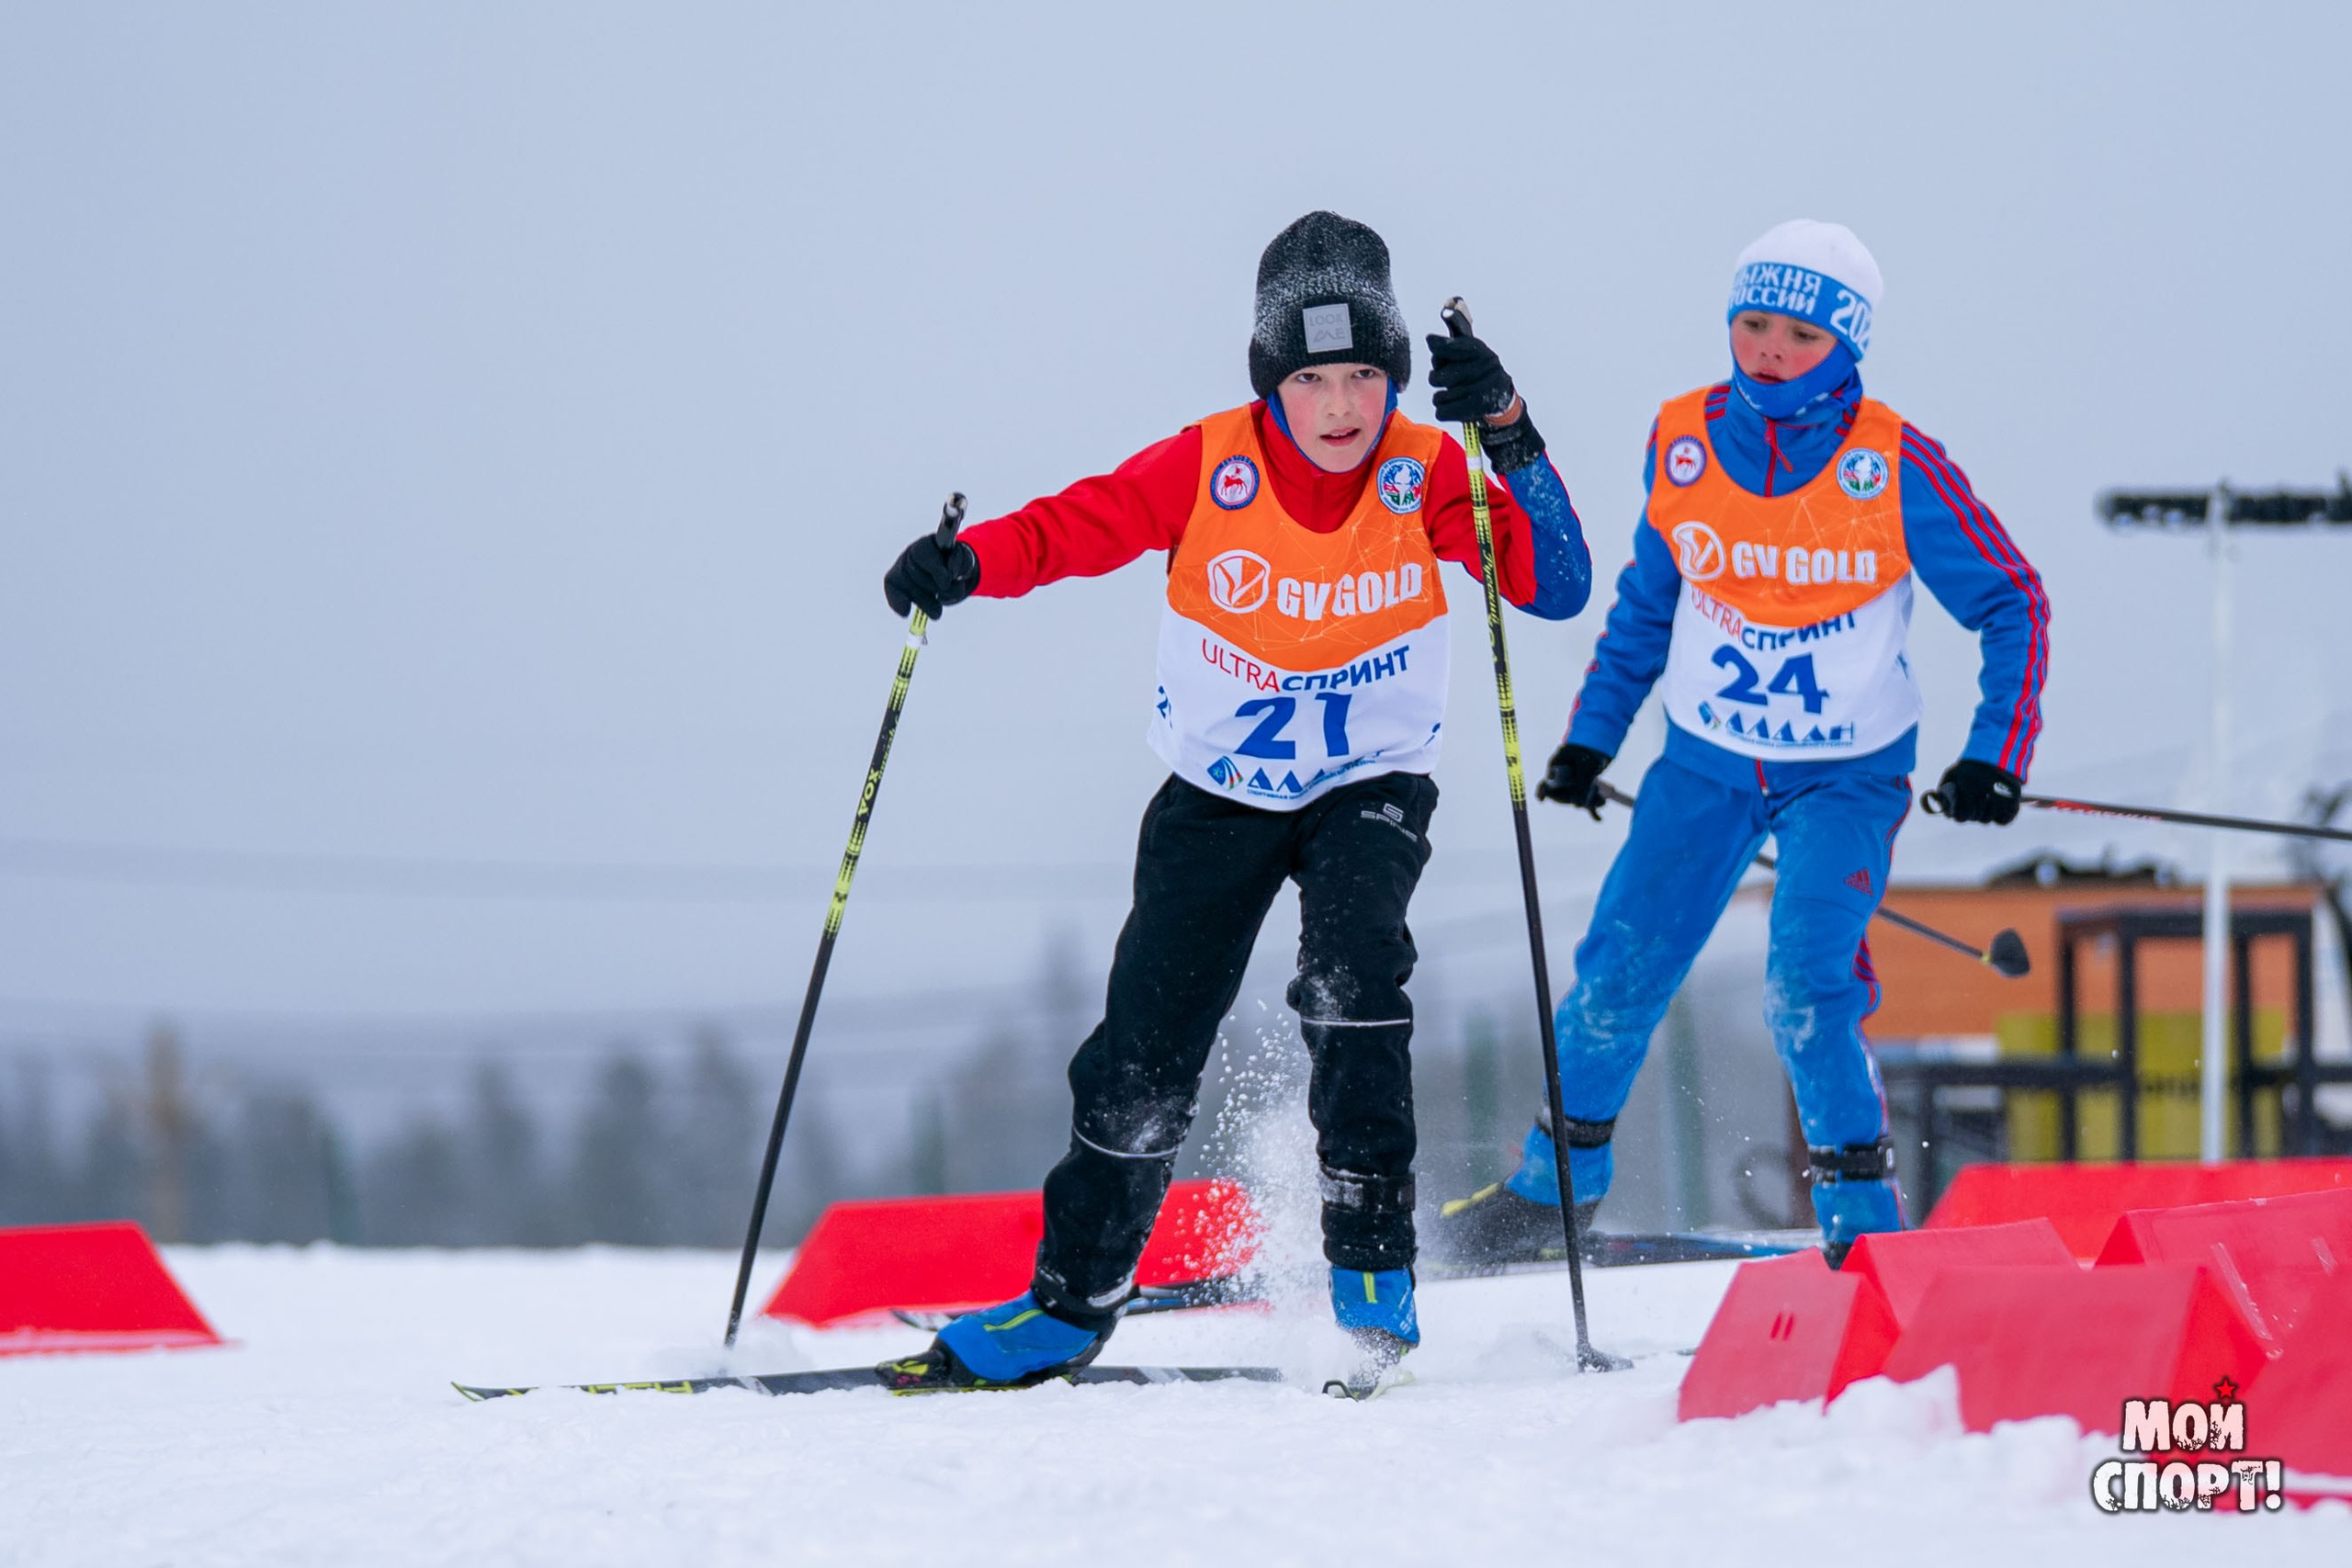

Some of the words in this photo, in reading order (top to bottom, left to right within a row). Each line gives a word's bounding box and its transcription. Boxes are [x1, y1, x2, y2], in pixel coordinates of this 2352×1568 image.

[1736, 264, 1822, 296] ЫЖНЯ
[1277, 577, 1331, 621] GV
[1332, 562, 1422, 616] GOLD
[1733, 540, 1778, 578] GV
[1786, 546, 1876, 585] GOLD
[1712, 643, 1829, 715] 24
[1234, 692, 1352, 761] 21
